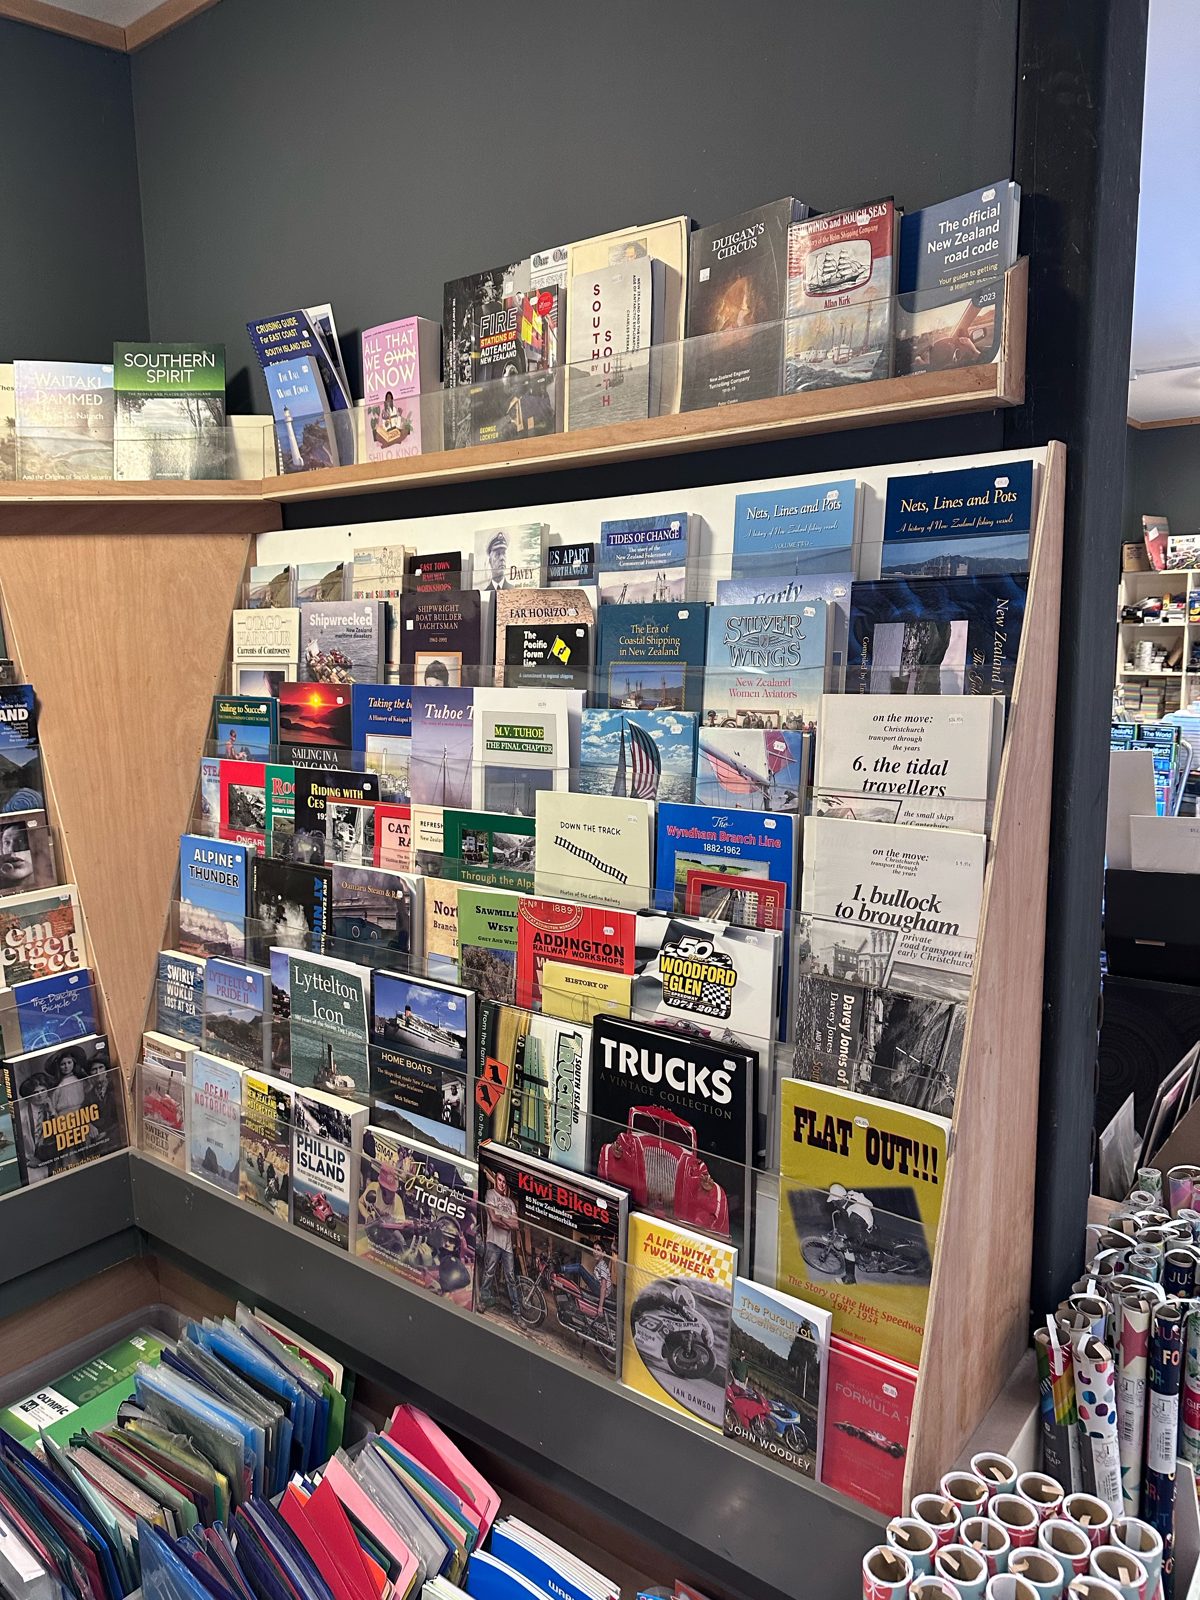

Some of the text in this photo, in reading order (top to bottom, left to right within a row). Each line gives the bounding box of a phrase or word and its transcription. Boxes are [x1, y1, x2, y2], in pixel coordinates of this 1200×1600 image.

[938, 203, 1001, 236] The official
[711, 223, 765, 253] DUIGAN'S
[927, 220, 1001, 254] New Zealand
[717, 238, 758, 261] CIRCUS
[944, 237, 1000, 265] road code
[978, 291, 996, 303] 2023
[256, 316, 298, 333] CRUISING GUIDE
[480, 307, 518, 338] FIRE
[260, 328, 298, 344] For EAST COAST
[364, 329, 414, 356] ALL THAT
[265, 340, 312, 358] SOUTH ISLAND 2025
[364, 347, 417, 370] WE OWN
[480, 340, 517, 357] AOTEAROA
[480, 350, 517, 366] NEW ZEALAND
[124, 353, 215, 371] SOUTHERN
[34, 372, 101, 391] WAITAKI
[147, 369, 195, 384] SPIRIT
[365, 362, 415, 393] KNOW
[36, 392, 103, 410] DAMMED
[480, 425, 497, 435] GEORGE
[480, 431, 499, 442] LOCKYER
[746, 496, 842, 522] Nets, Lines and Pots
[900, 487, 1017, 513] Nets, Lines and Pots
[609, 528, 681, 545] TIDES OF CHANGE
[510, 565, 534, 582] DAVEY
[309, 610, 373, 630] Shipwrecked
[415, 612, 463, 622] BOAT BUILDER
[417, 604, 459, 614] SHIPWRIGHT
[418, 621, 459, 631] YACHTSMAN
[523, 630, 538, 640] The
[630, 622, 671, 636] The Era of
[723, 613, 807, 646] SILVER
[523, 639, 548, 650] Pacific
[619, 632, 681, 648] Coastal Shipping
[619, 643, 680, 658] in New Zealand
[991, 597, 1009, 684] New Zealand
[523, 649, 544, 660] Forum
[523, 658, 538, 668] Line
[729, 640, 802, 669] WINGS
[729, 687, 798, 699] Women Aviators
[735, 676, 792, 688] New Zealand
[368, 696, 406, 712] Taking the
[424, 702, 464, 721] Tuhoe
[872, 713, 934, 725] on the move:
[883, 724, 925, 734] Christchurch
[494, 725, 545, 739] M.V. TUHOE
[867, 734, 924, 745] transport through
[486, 740, 554, 754] THE FINAL CHAPTER
[892, 743, 921, 754] the years
[851, 754, 950, 777] 6. the tidal
[310, 783, 364, 801] RIDING WITH
[861, 776, 948, 799] travellers
[903, 810, 955, 824] the small ships
[560, 821, 622, 836] DOWN THE TRACK
[665, 826, 782, 851] Wyndham Branch Line
[193, 848, 235, 869] ALPINE
[703, 842, 742, 857] 1882-1962
[871, 848, 930, 865] on the move:
[187, 862, 240, 889] THUNDER
[460, 869, 536, 892] Through the Alps
[851, 883, 944, 915] 1. bullock
[763, 894, 777, 930] RETRO
[833, 901, 961, 938] to brougham
[433, 919, 458, 933] Branch
[487, 921, 515, 935] WEST
[532, 931, 625, 960] ADDINGTON
[901, 932, 934, 947] private
[532, 942, 626, 968] RAILWAY WORKSHOPS
[166, 963, 195, 986] SWIRLY
[659, 954, 738, 989] WOODFORD
[293, 964, 361, 1004] Lyttelton
[668, 974, 703, 999] GLEN
[41, 1000, 71, 1014] Bicycle
[311, 999, 345, 1027] Icon
[667, 995, 728, 1018] 1974-2024
[825, 992, 840, 1053] Davey Jones
[381, 1051, 433, 1075] HOME BOATS
[599, 1035, 734, 1106] TRUCKS
[571, 1057, 583, 1126] SOUTH ISLAND
[42, 1103, 101, 1140] DIGGING
[56, 1125, 90, 1153] DEEP
[792, 1104, 939, 1185] FLAT OUT!!!
[296, 1135, 346, 1167] PHILLIP
[296, 1149, 346, 1184] ISLAND
[413, 1185, 468, 1221] Trades
[516, 1170, 612, 1226] Kiwi Bikers
[645, 1231, 713, 1266] A LIFE WITH
[643, 1241, 716, 1281] TWO WHEELS
[672, 1385, 717, 1415] IAN DAWSON
[726, 1422, 811, 1473] JOHN WOODLEY
